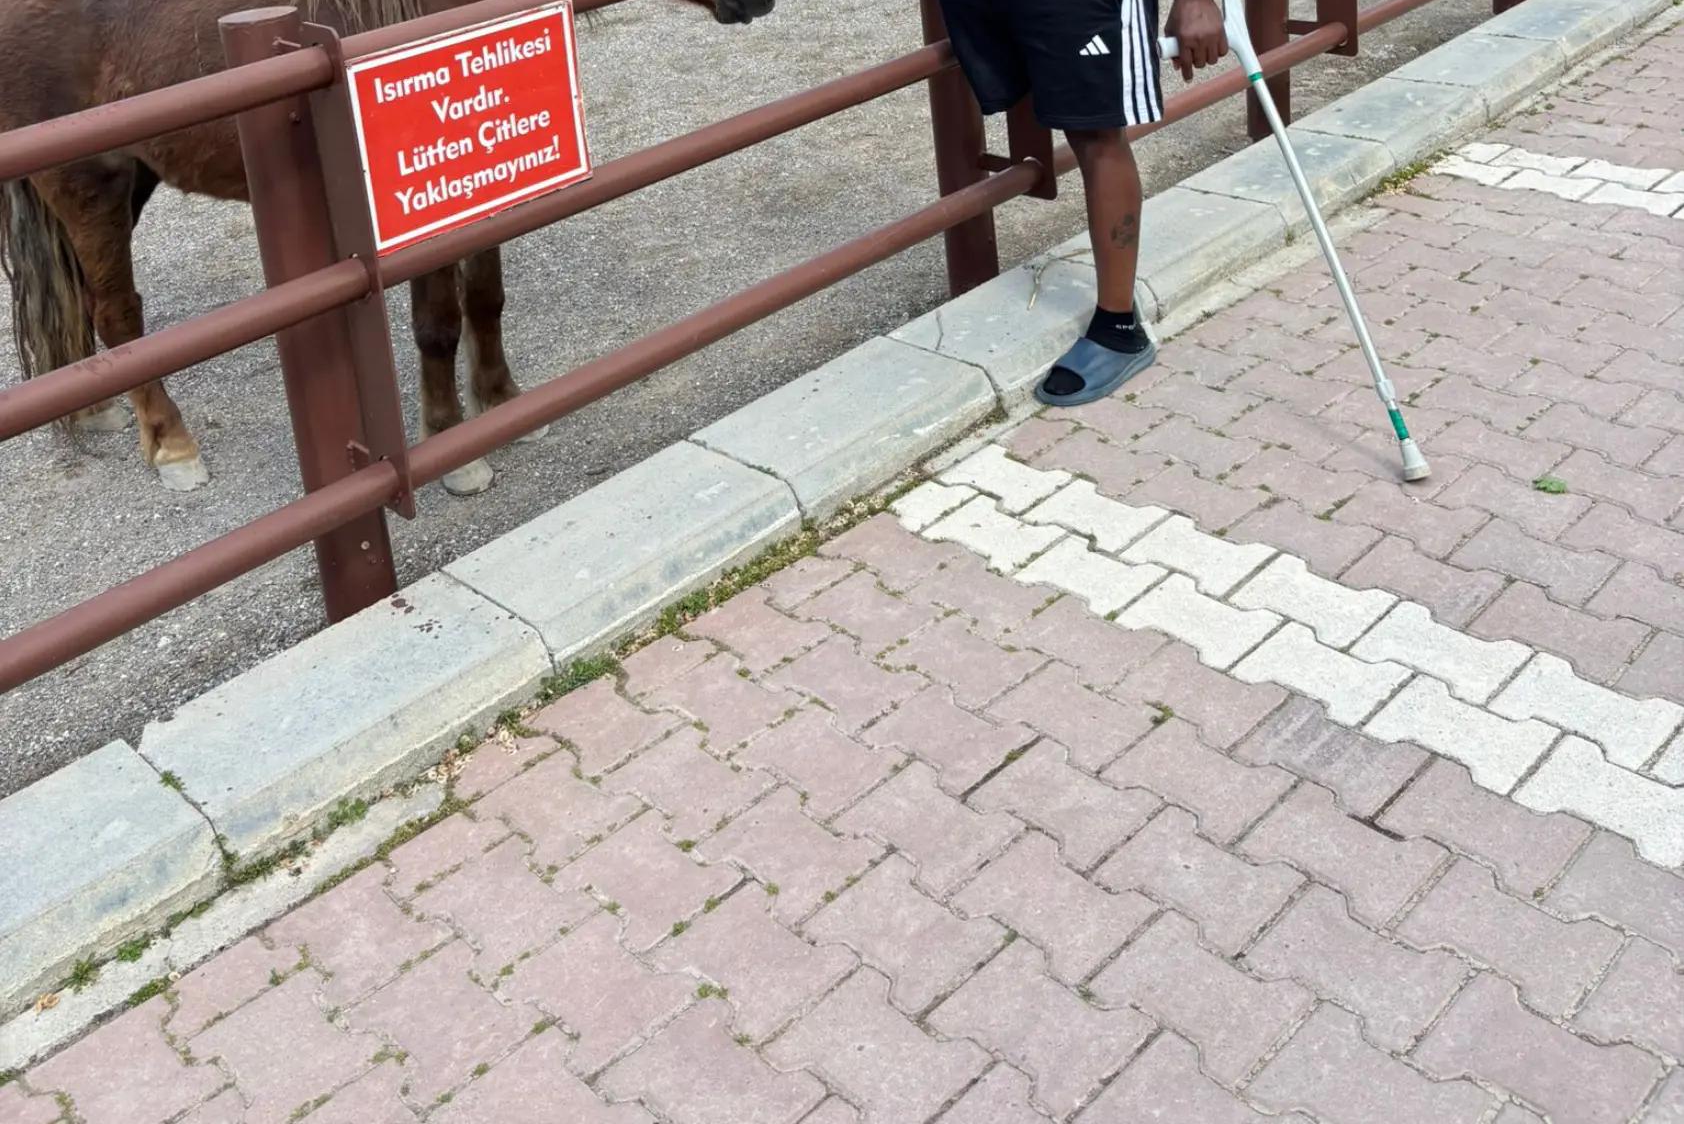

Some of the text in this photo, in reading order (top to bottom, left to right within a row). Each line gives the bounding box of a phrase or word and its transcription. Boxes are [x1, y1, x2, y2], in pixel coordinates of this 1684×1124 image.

[374, 28, 551, 104] Isırma Tehlikesi
[431, 84, 511, 124] Vardır.
[394, 134, 561, 215] Yaklaşmayınız!
[397, 109, 551, 176] Lütfen Çitlere
